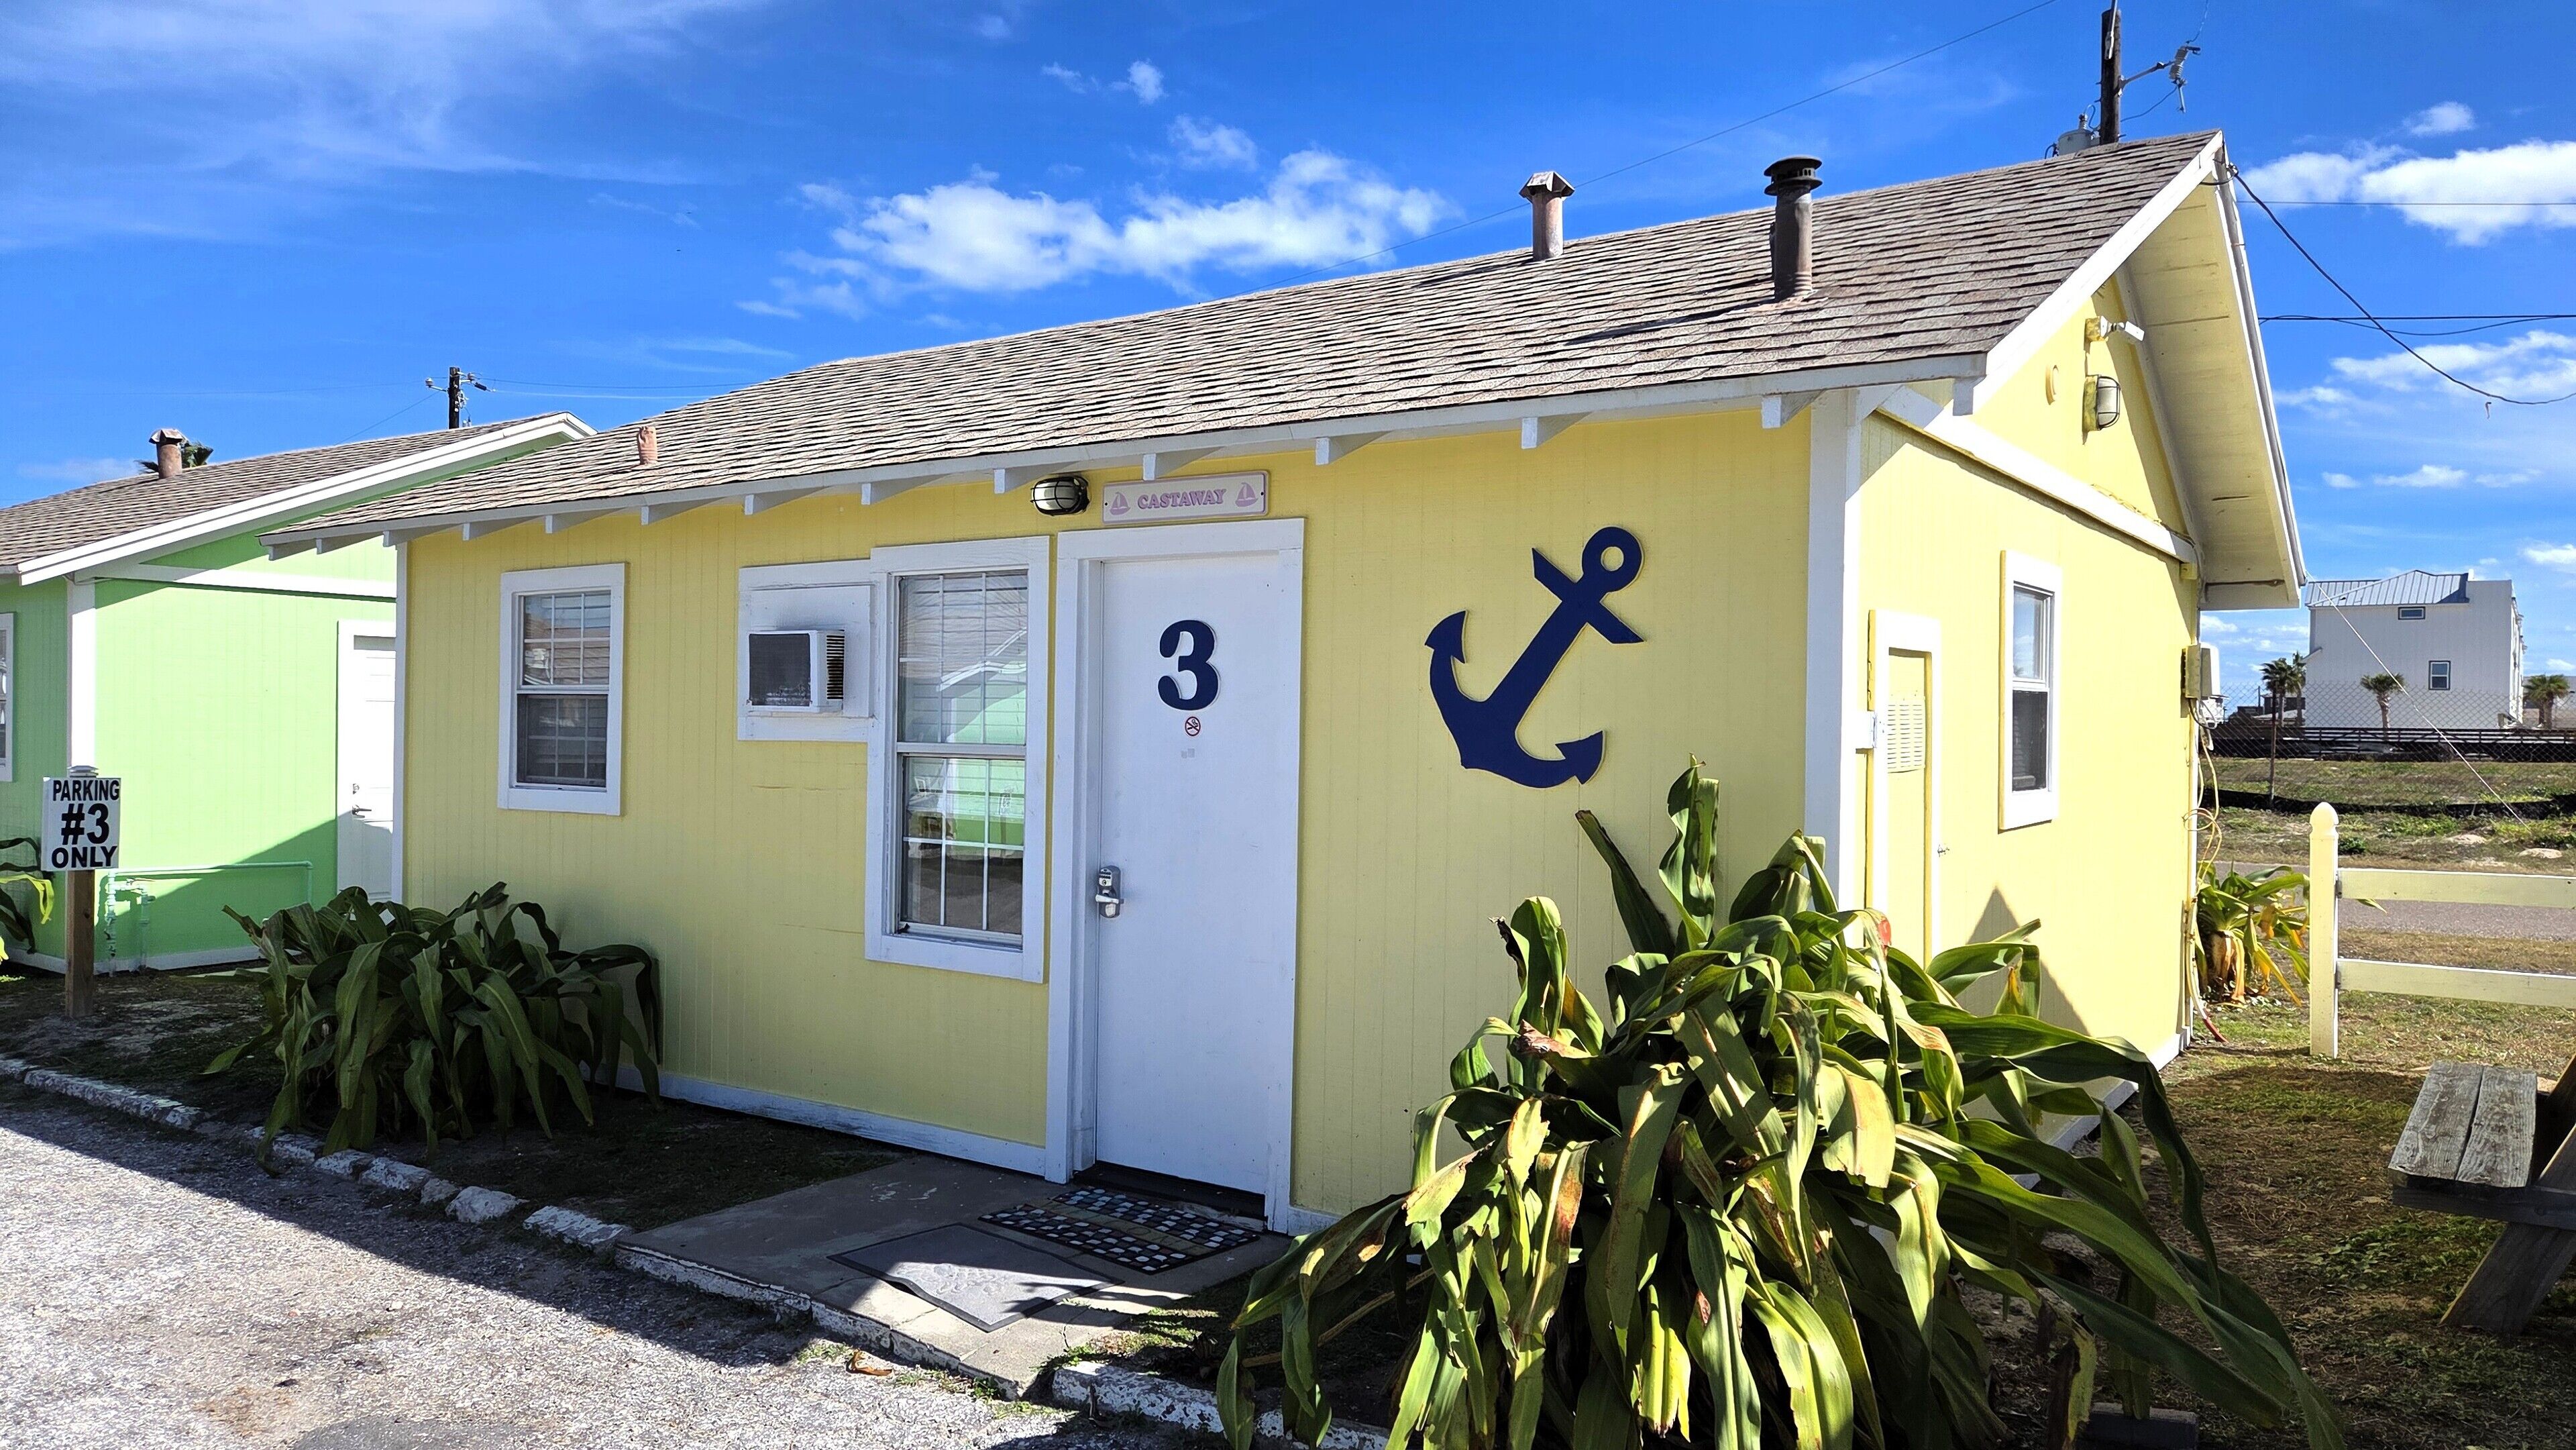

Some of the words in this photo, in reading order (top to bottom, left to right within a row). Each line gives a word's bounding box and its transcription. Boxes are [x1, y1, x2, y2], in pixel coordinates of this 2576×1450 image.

[1137, 488, 1226, 509] CASTAWAY
[1157, 619, 1219, 711] 3
[52, 780, 119, 801] PARKING
[61, 802, 109, 845] #3
[51, 845, 117, 868] ONLY
